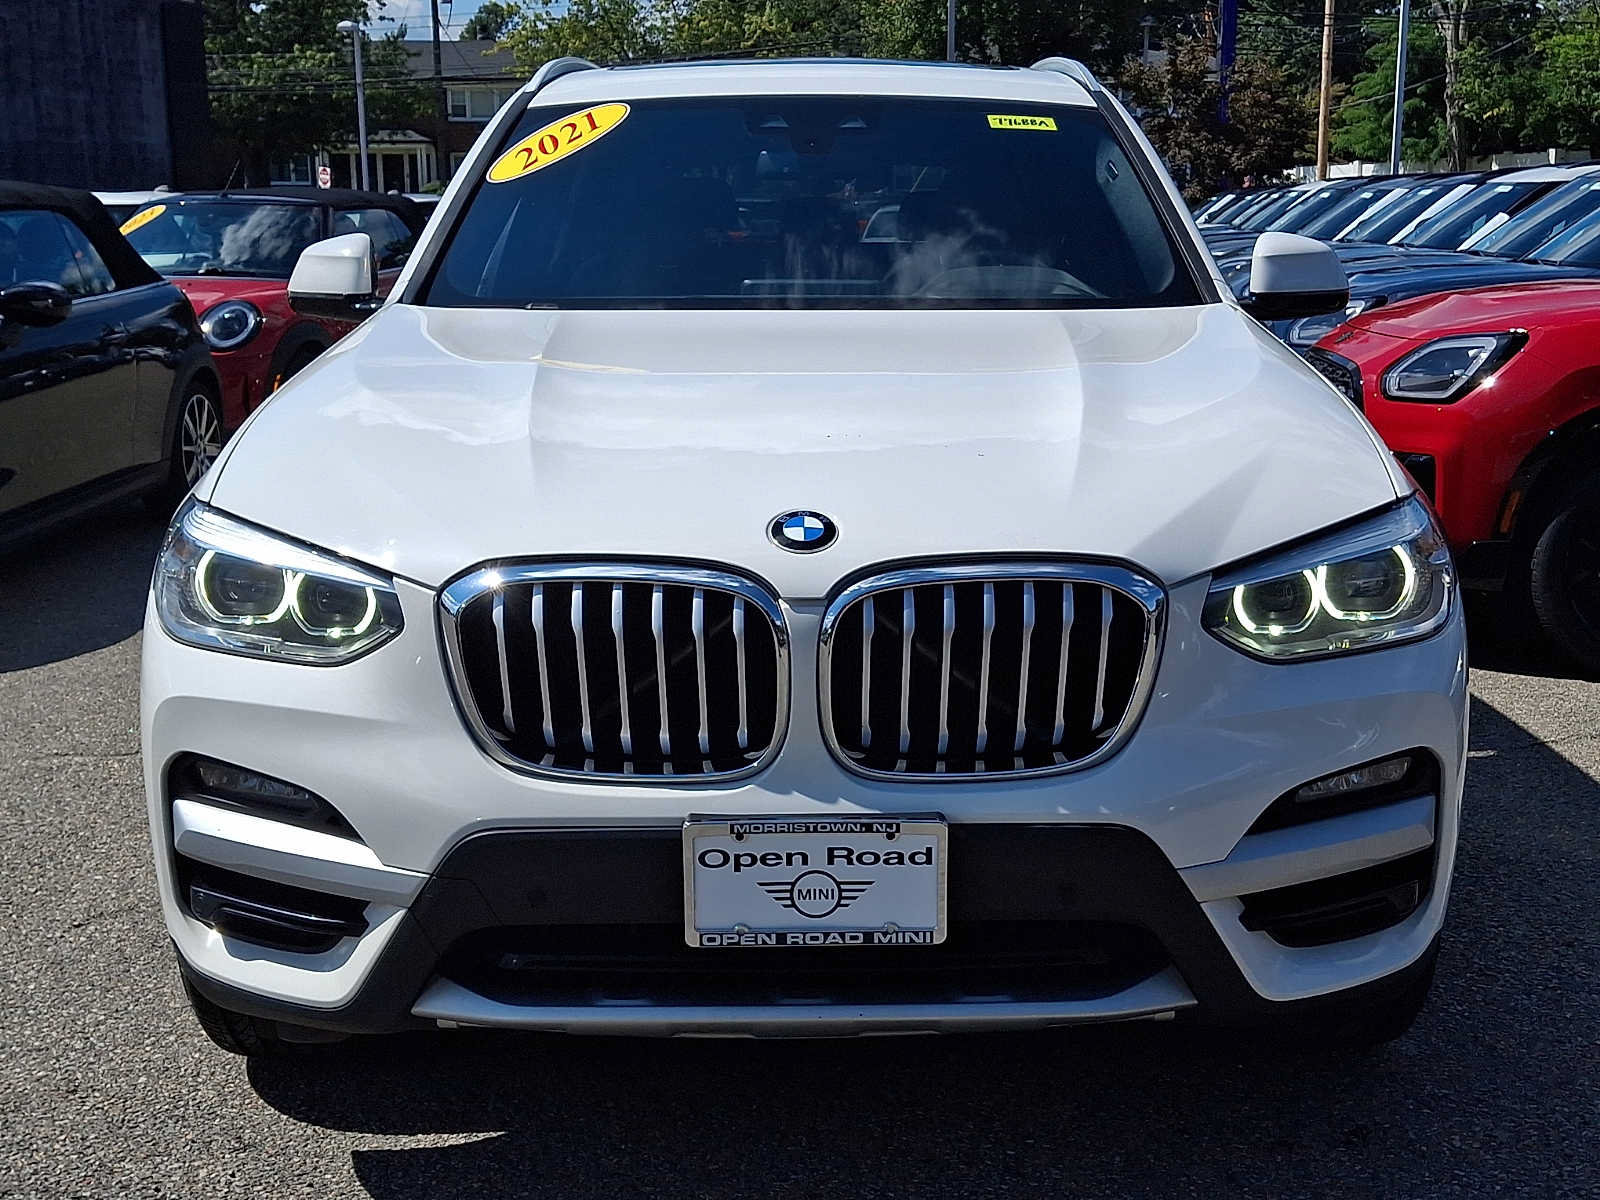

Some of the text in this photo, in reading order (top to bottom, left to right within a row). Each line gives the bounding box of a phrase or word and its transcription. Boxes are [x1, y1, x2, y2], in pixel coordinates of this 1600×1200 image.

[514, 111, 600, 171] 2021
[873, 822, 897, 833] NJ
[698, 846, 933, 873] Open Road
[797, 888, 836, 901] MINI
[702, 931, 931, 946] OPEN ROAD MINI
